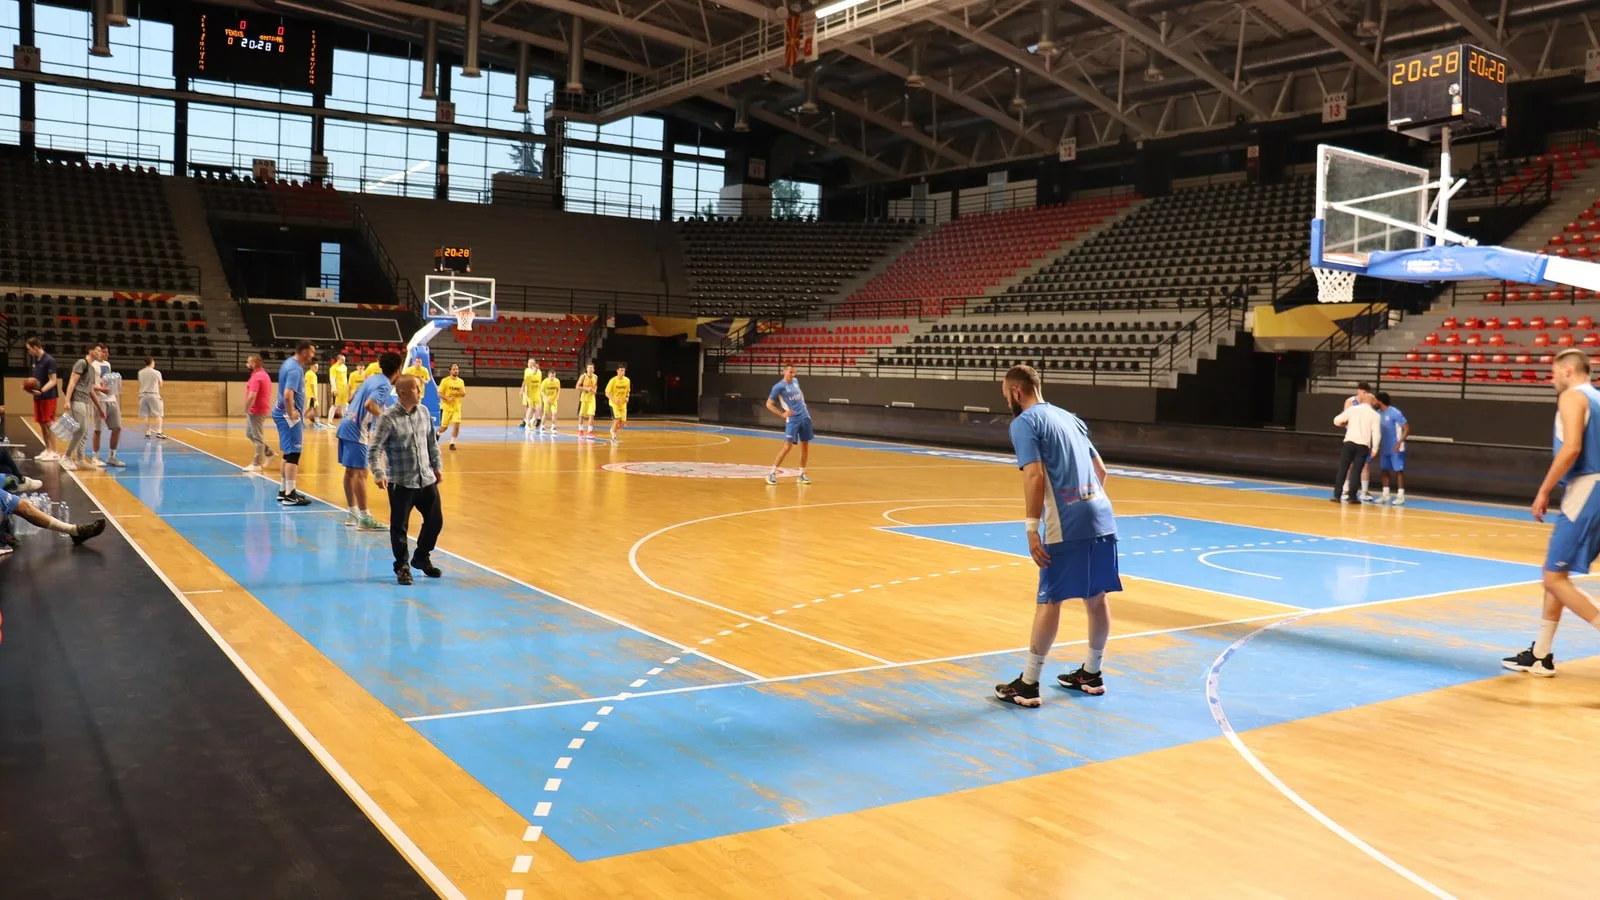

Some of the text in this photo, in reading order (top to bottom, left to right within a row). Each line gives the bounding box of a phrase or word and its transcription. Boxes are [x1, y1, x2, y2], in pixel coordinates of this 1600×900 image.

[1392, 51, 1459, 85] 20:28
[1469, 51, 1505, 84] 20:28
[440, 109, 451, 121] 10
[1328, 105, 1341, 117] 13
[444, 247, 470, 257] 20:28
